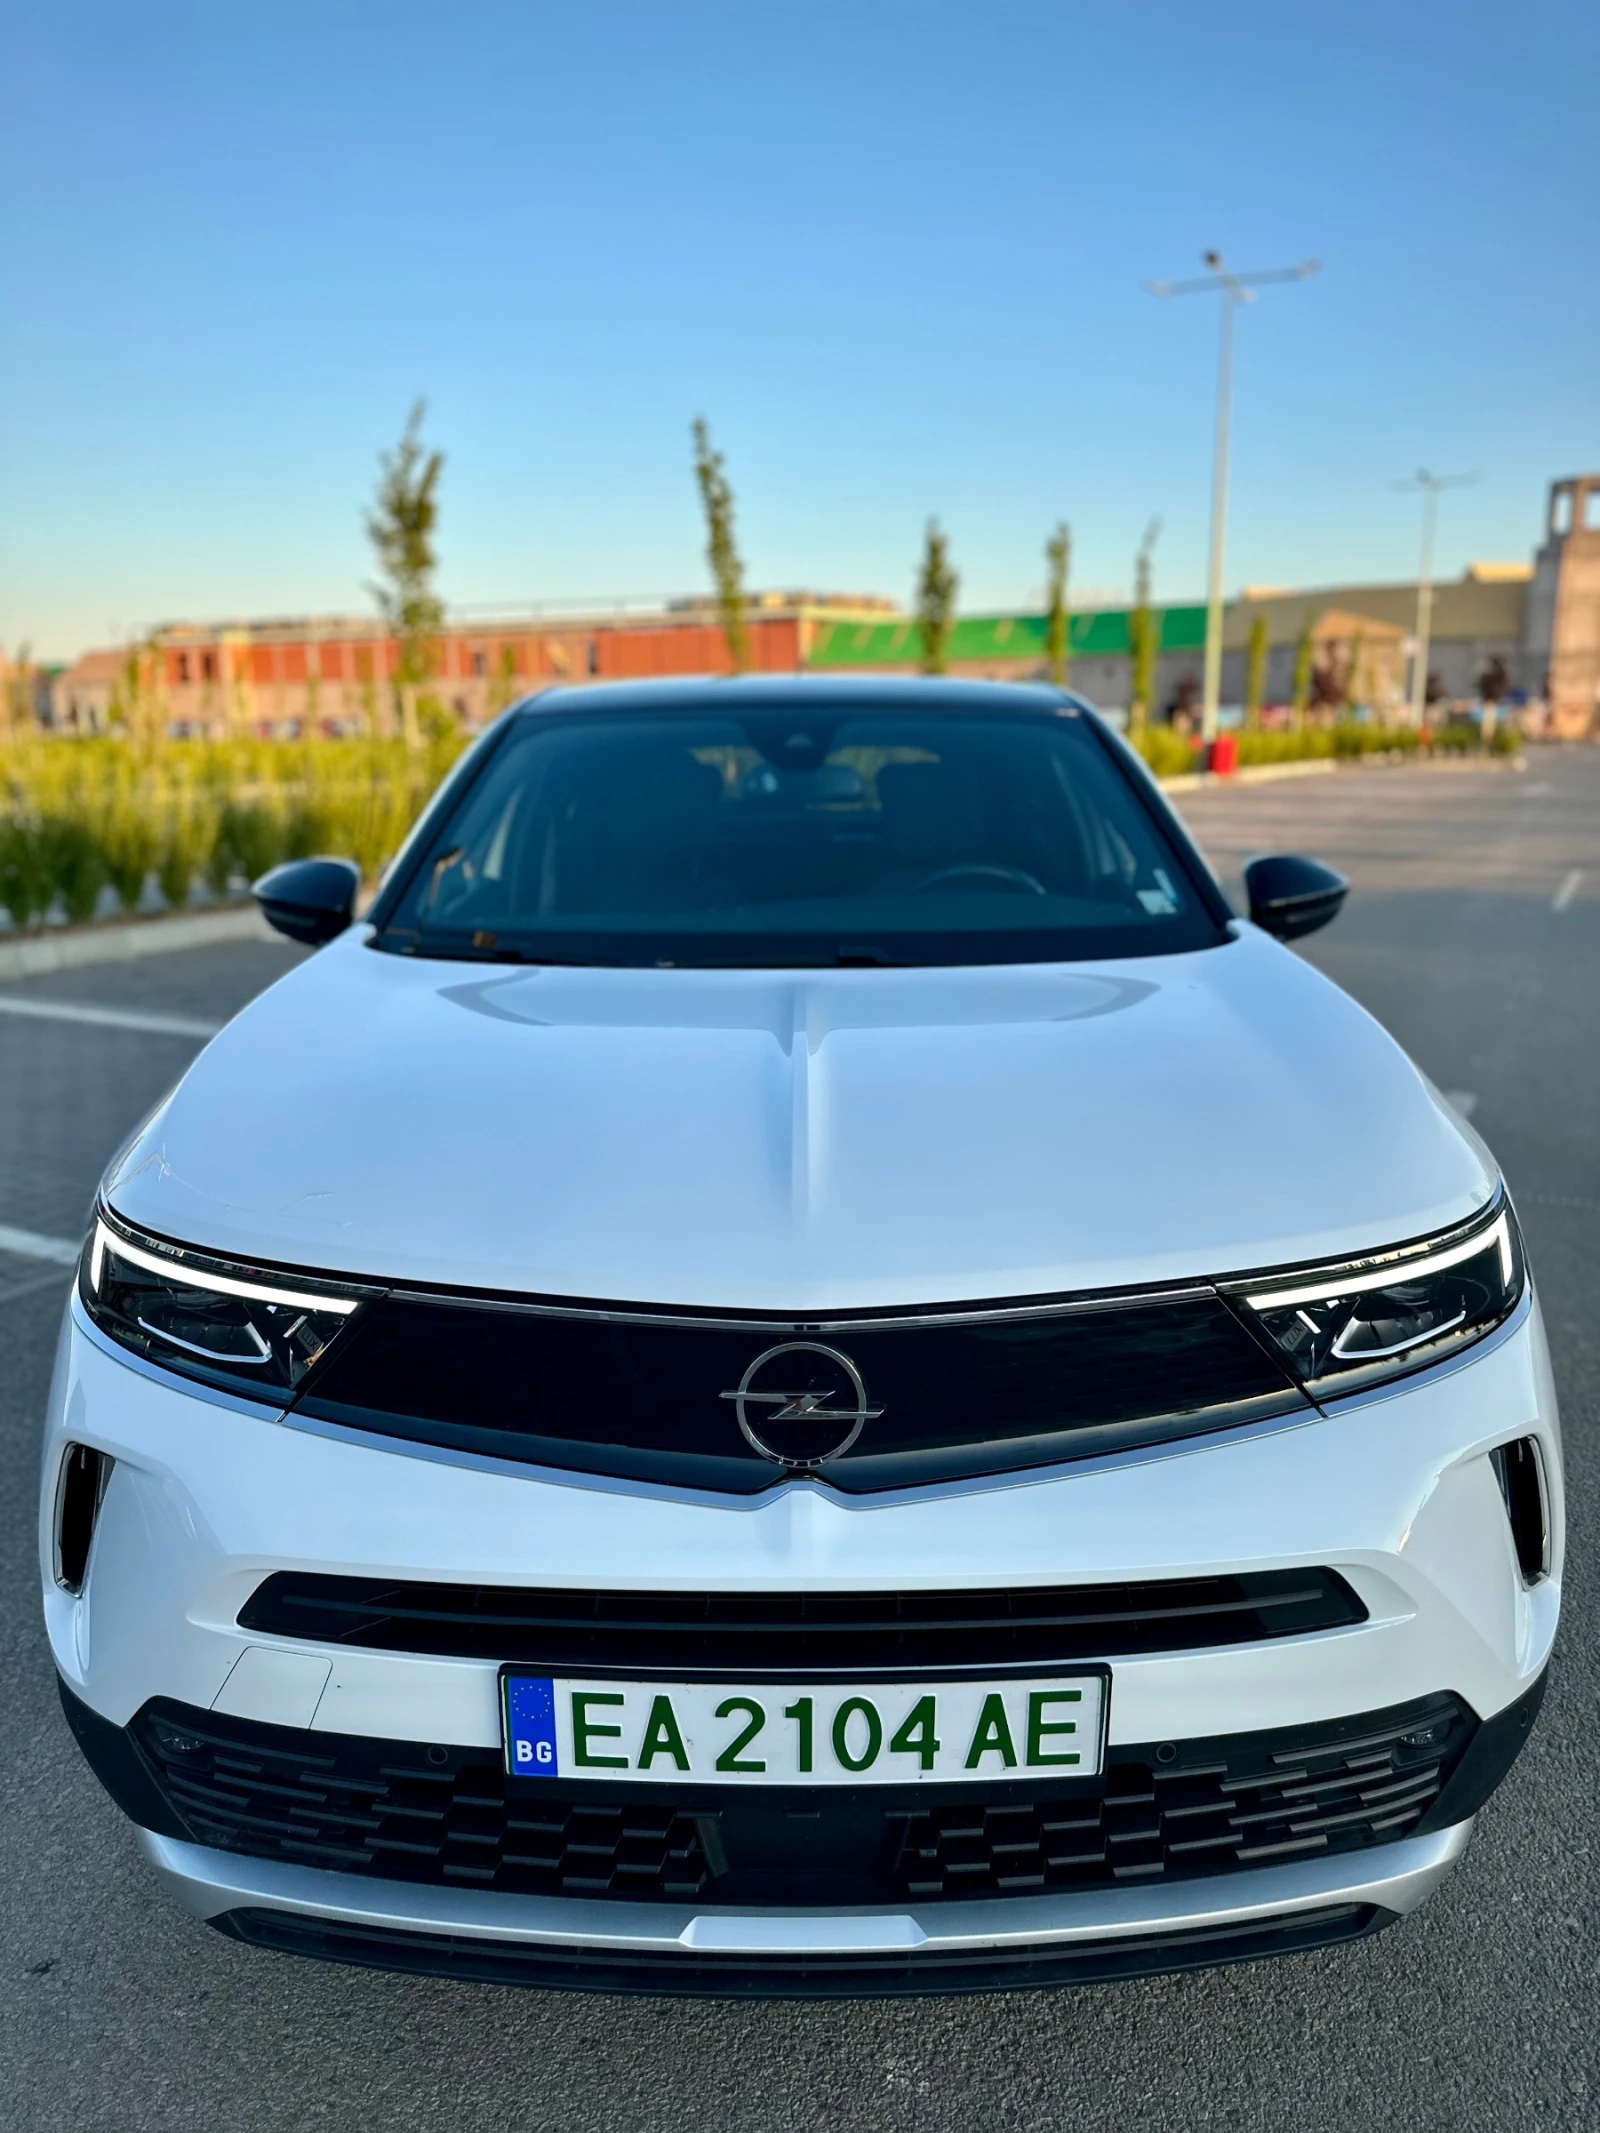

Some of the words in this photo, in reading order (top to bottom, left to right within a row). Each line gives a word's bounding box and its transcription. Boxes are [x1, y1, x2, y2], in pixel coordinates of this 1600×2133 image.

[516, 1739, 552, 1763] BG
[571, 1691, 691, 1771] EA
[714, 1695, 941, 1773] 2104
[964, 1690, 1082, 1769] AE
